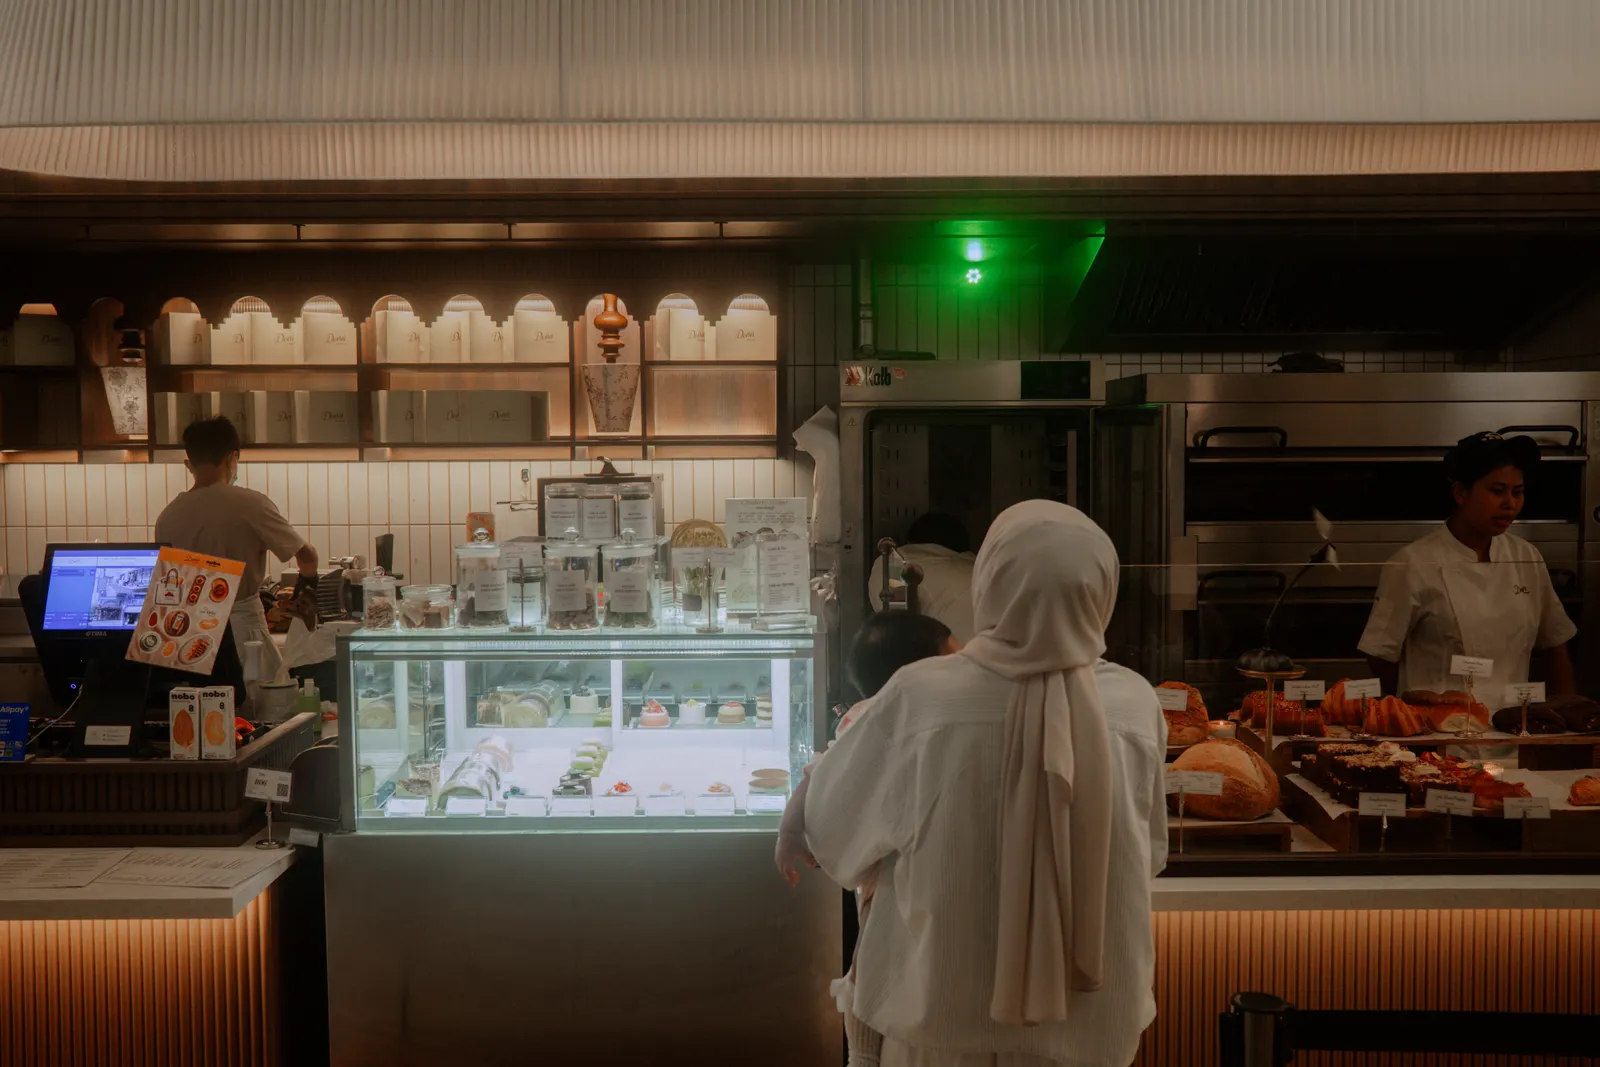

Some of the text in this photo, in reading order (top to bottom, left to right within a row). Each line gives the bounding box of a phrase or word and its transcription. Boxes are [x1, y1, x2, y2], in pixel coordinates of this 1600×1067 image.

[171, 692, 196, 700] nobo
[202, 690, 226, 698] nobo
[188, 704, 195, 712] 8
[219, 702, 225, 710] 8
